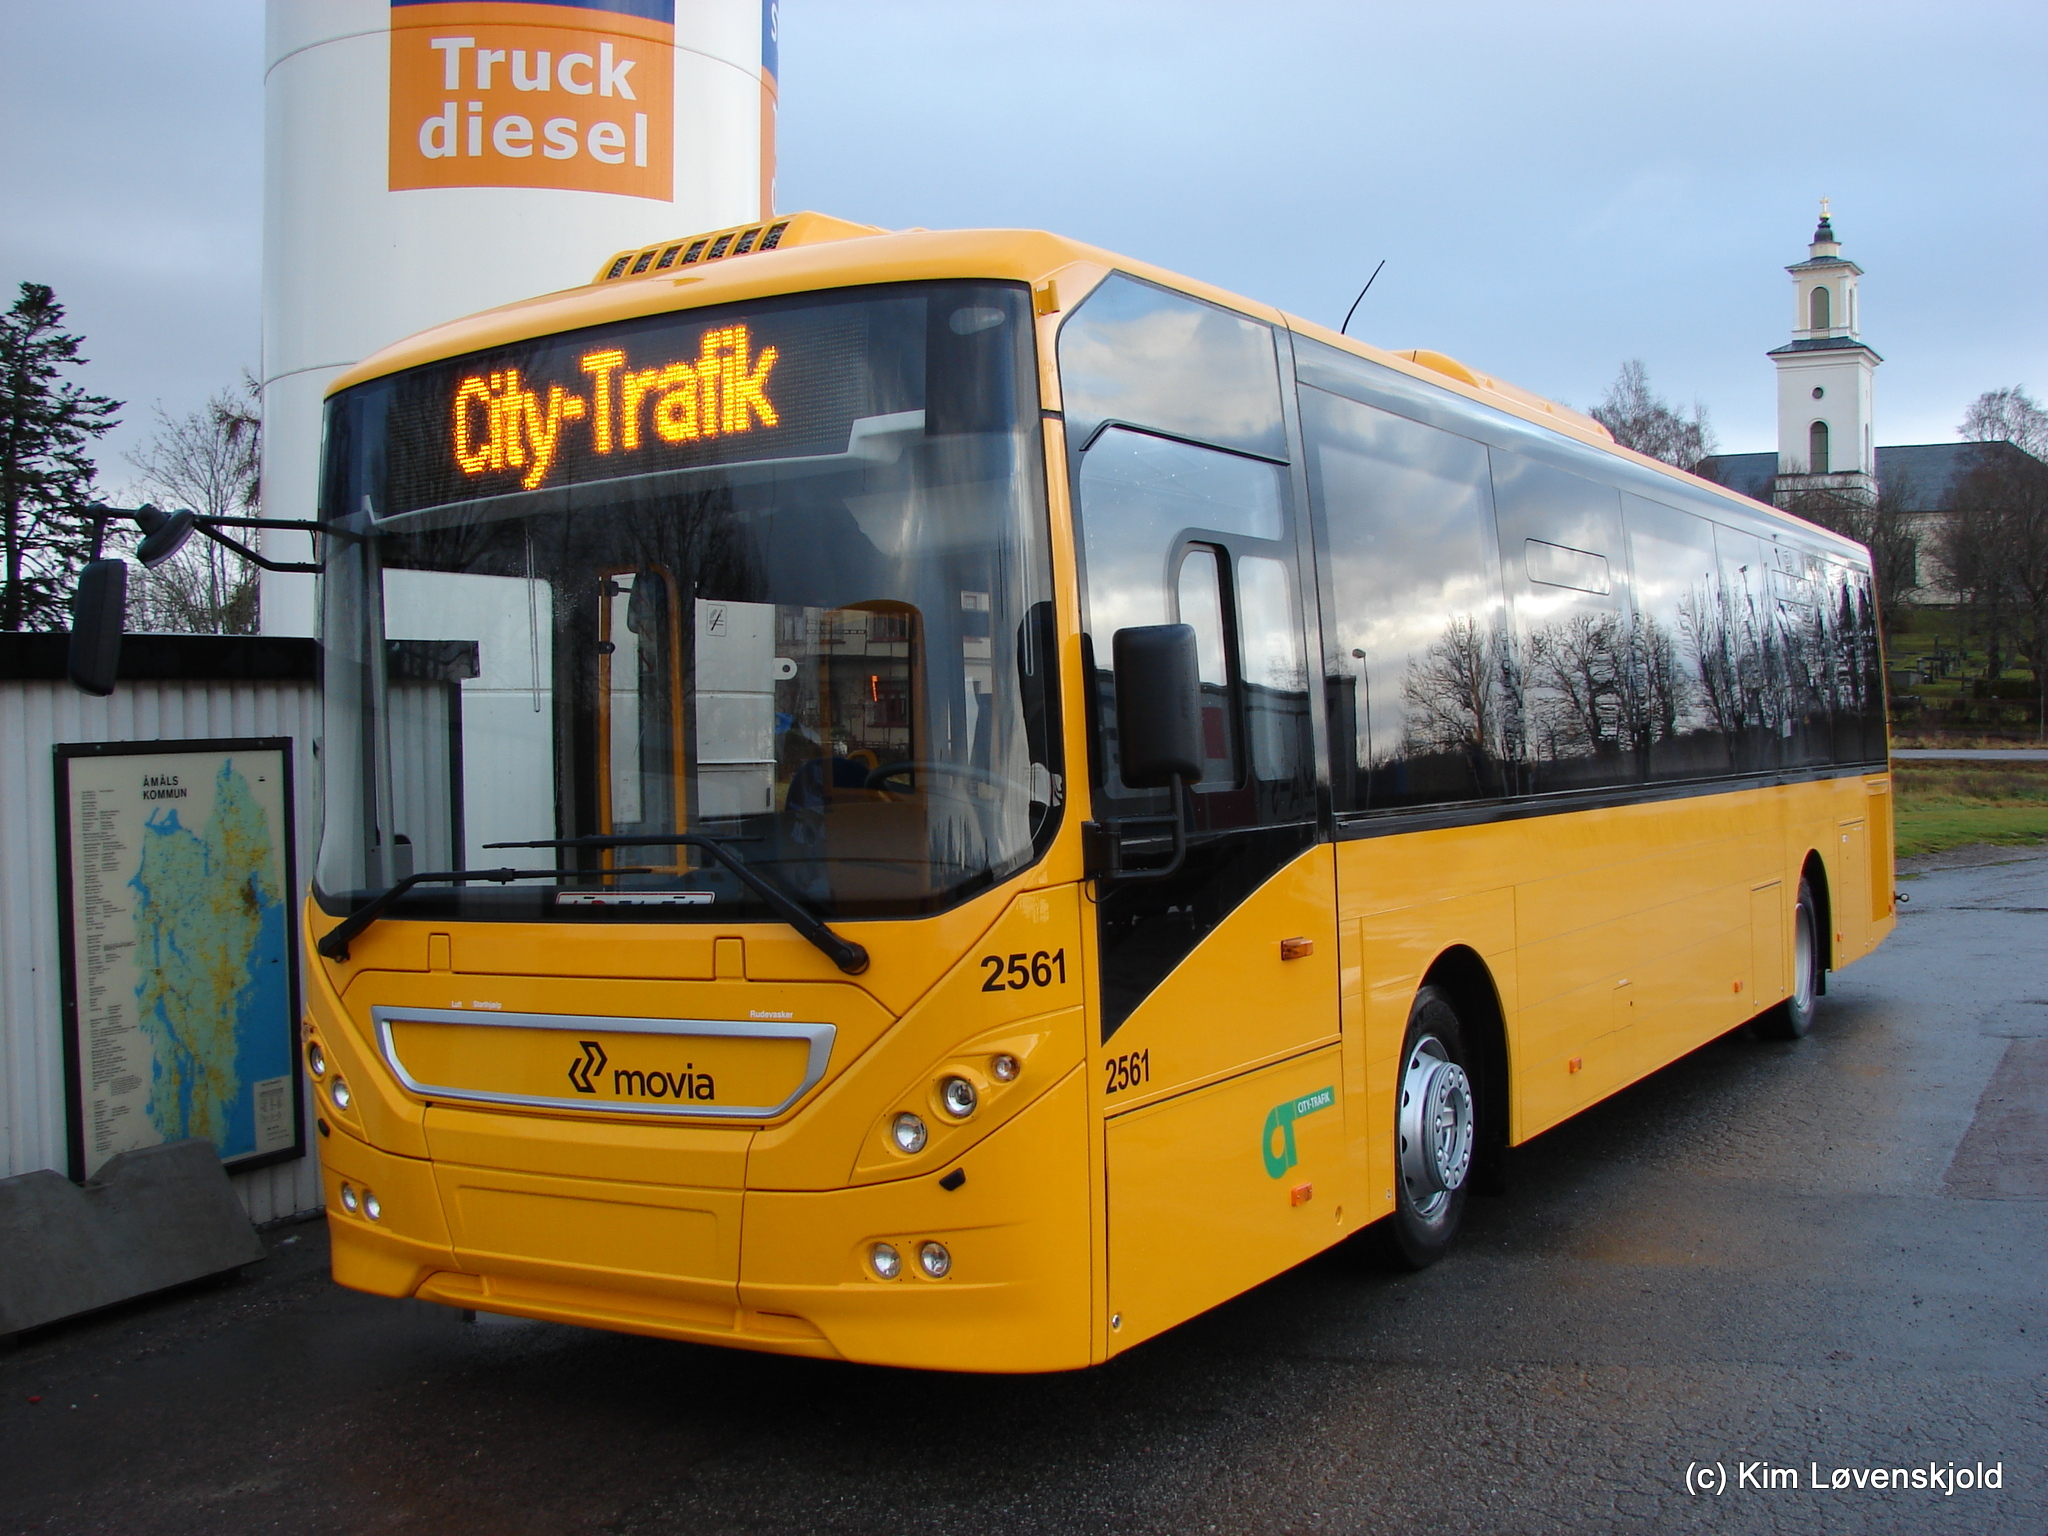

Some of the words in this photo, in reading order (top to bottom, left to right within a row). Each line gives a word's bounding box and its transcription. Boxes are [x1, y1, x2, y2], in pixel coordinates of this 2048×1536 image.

[432, 37, 637, 101] Truck
[419, 102, 648, 168] diesel
[455, 323, 779, 490] City-Trafik
[143, 774, 179, 787] ÅMÅLS
[143, 788, 187, 800] KOMMUN
[981, 948, 1067, 992] 2561
[614, 1062, 715, 1100] movia
[1105, 1049, 1150, 1095] 2561
[1297, 1091, 1331, 1114] CITY-TRAFIK
